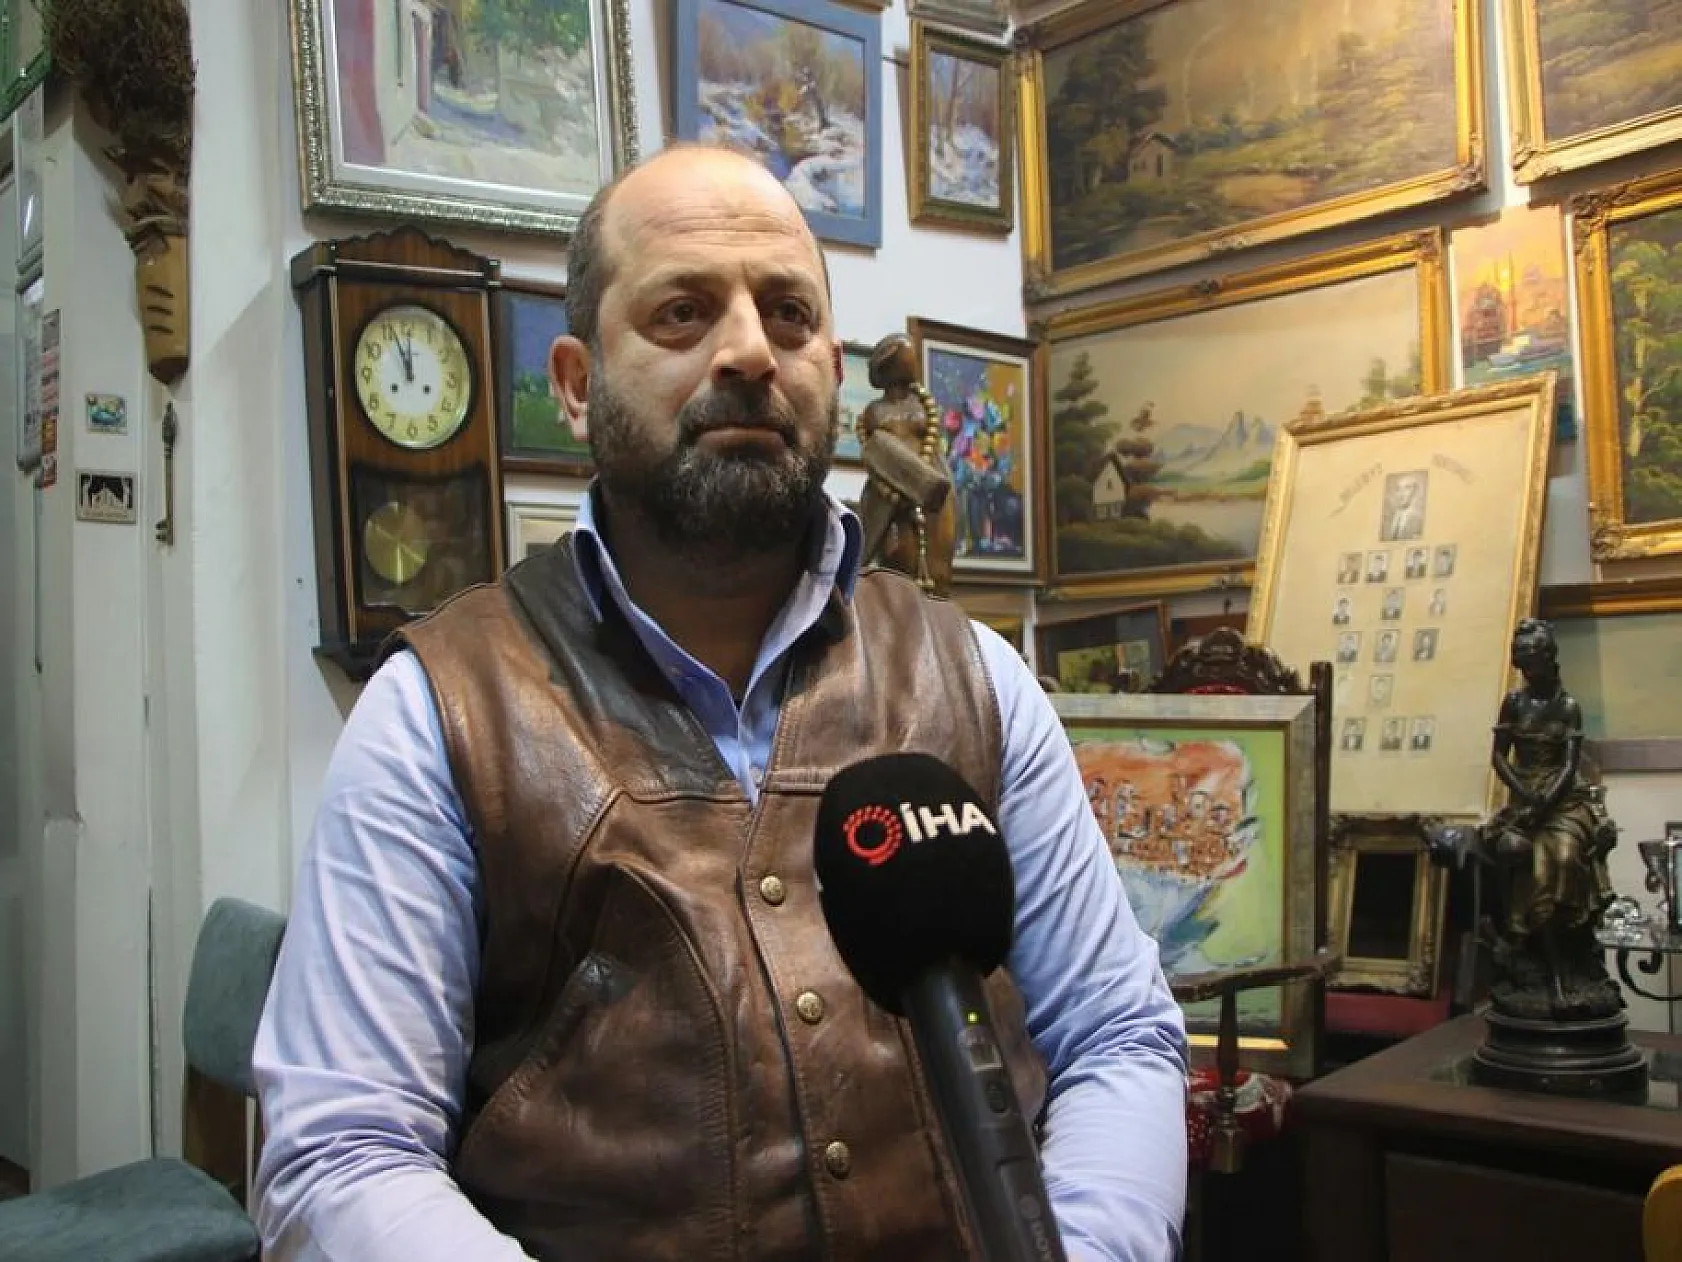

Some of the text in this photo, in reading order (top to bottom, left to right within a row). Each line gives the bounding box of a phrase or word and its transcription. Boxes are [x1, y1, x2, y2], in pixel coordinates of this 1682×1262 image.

[366, 342, 381, 360] 10
[361, 366, 372, 384] 9
[447, 372, 458, 389] 3
[369, 392, 379, 410] 8
[385, 413, 396, 430] 7
[407, 418, 418, 439] 6
[427, 415, 438, 432] 5
[899, 802, 997, 843] İHA
